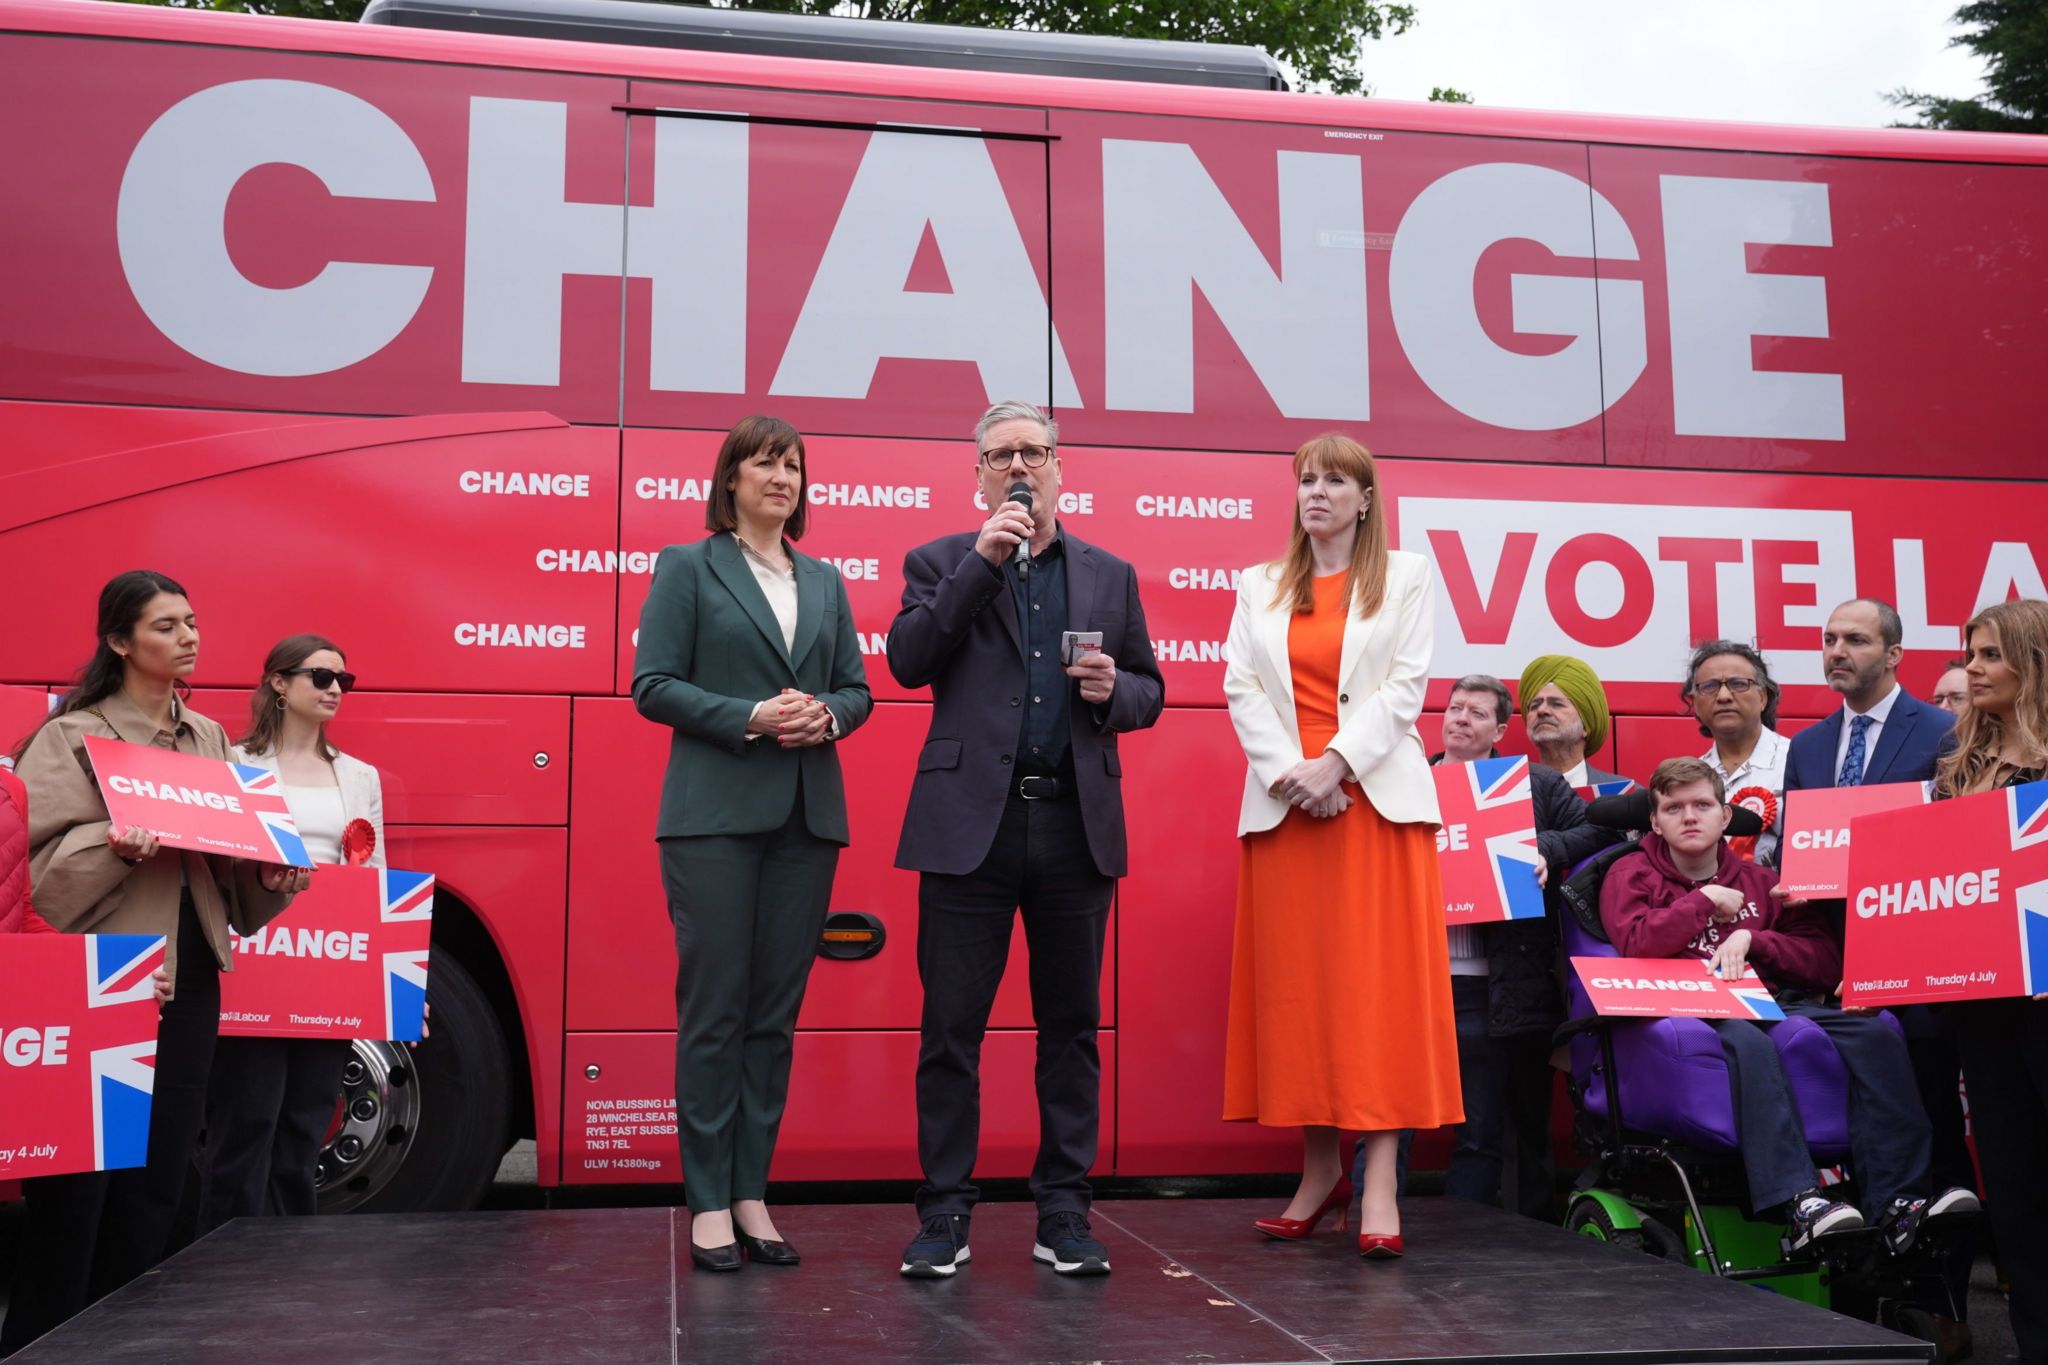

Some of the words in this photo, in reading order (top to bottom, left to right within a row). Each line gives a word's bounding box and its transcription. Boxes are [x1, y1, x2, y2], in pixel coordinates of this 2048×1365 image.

[1324, 131, 1367, 140] EMERGENCY
[1368, 133, 1384, 141] EXIT
[117, 79, 1845, 441] CHANGE
[459, 471, 589, 497] CHANGE
[807, 483, 930, 508] CHANGE
[1136, 495, 1253, 519] CHANGE
[1426, 529, 1823, 651] VOTE
[454, 623, 585, 648] CHANGE
[109, 775, 243, 814] CHANGE
[1856, 868, 2000, 919] CHANGE
[1455, 901, 1475, 913] July
[1591, 977, 1716, 992] CHANGE
[1853, 981, 1873, 992] Vote
[1880, 978, 1909, 990] Labour
[1926, 973, 1968, 987] Thursday
[1968, 972, 1976, 983] 4
[1977, 970, 1997, 985] July
[236, 1012, 271, 1023] Labour
[289, 1014, 333, 1028] Thursday
[334, 1016, 341, 1025] 4
[342, 1016, 362, 1028] July
[586, 1100, 615, 1110] NOVA
[616, 1099, 661, 1109] BUSSING
[586, 1114, 597, 1124] 28
[599, 1113, 665, 1123] WINCHELSEA
[586, 1127, 609, 1138] RYE,
[611, 1126, 637, 1136] EAST
[17, 1146, 27, 1158] 4
[29, 1144, 58, 1160] July
[586, 1140, 610, 1150] TN31
[612, 1140, 630, 1149] 7EL
[584, 1160, 608, 1169] ULW
[612, 1159, 661, 1170] 14380kgs
